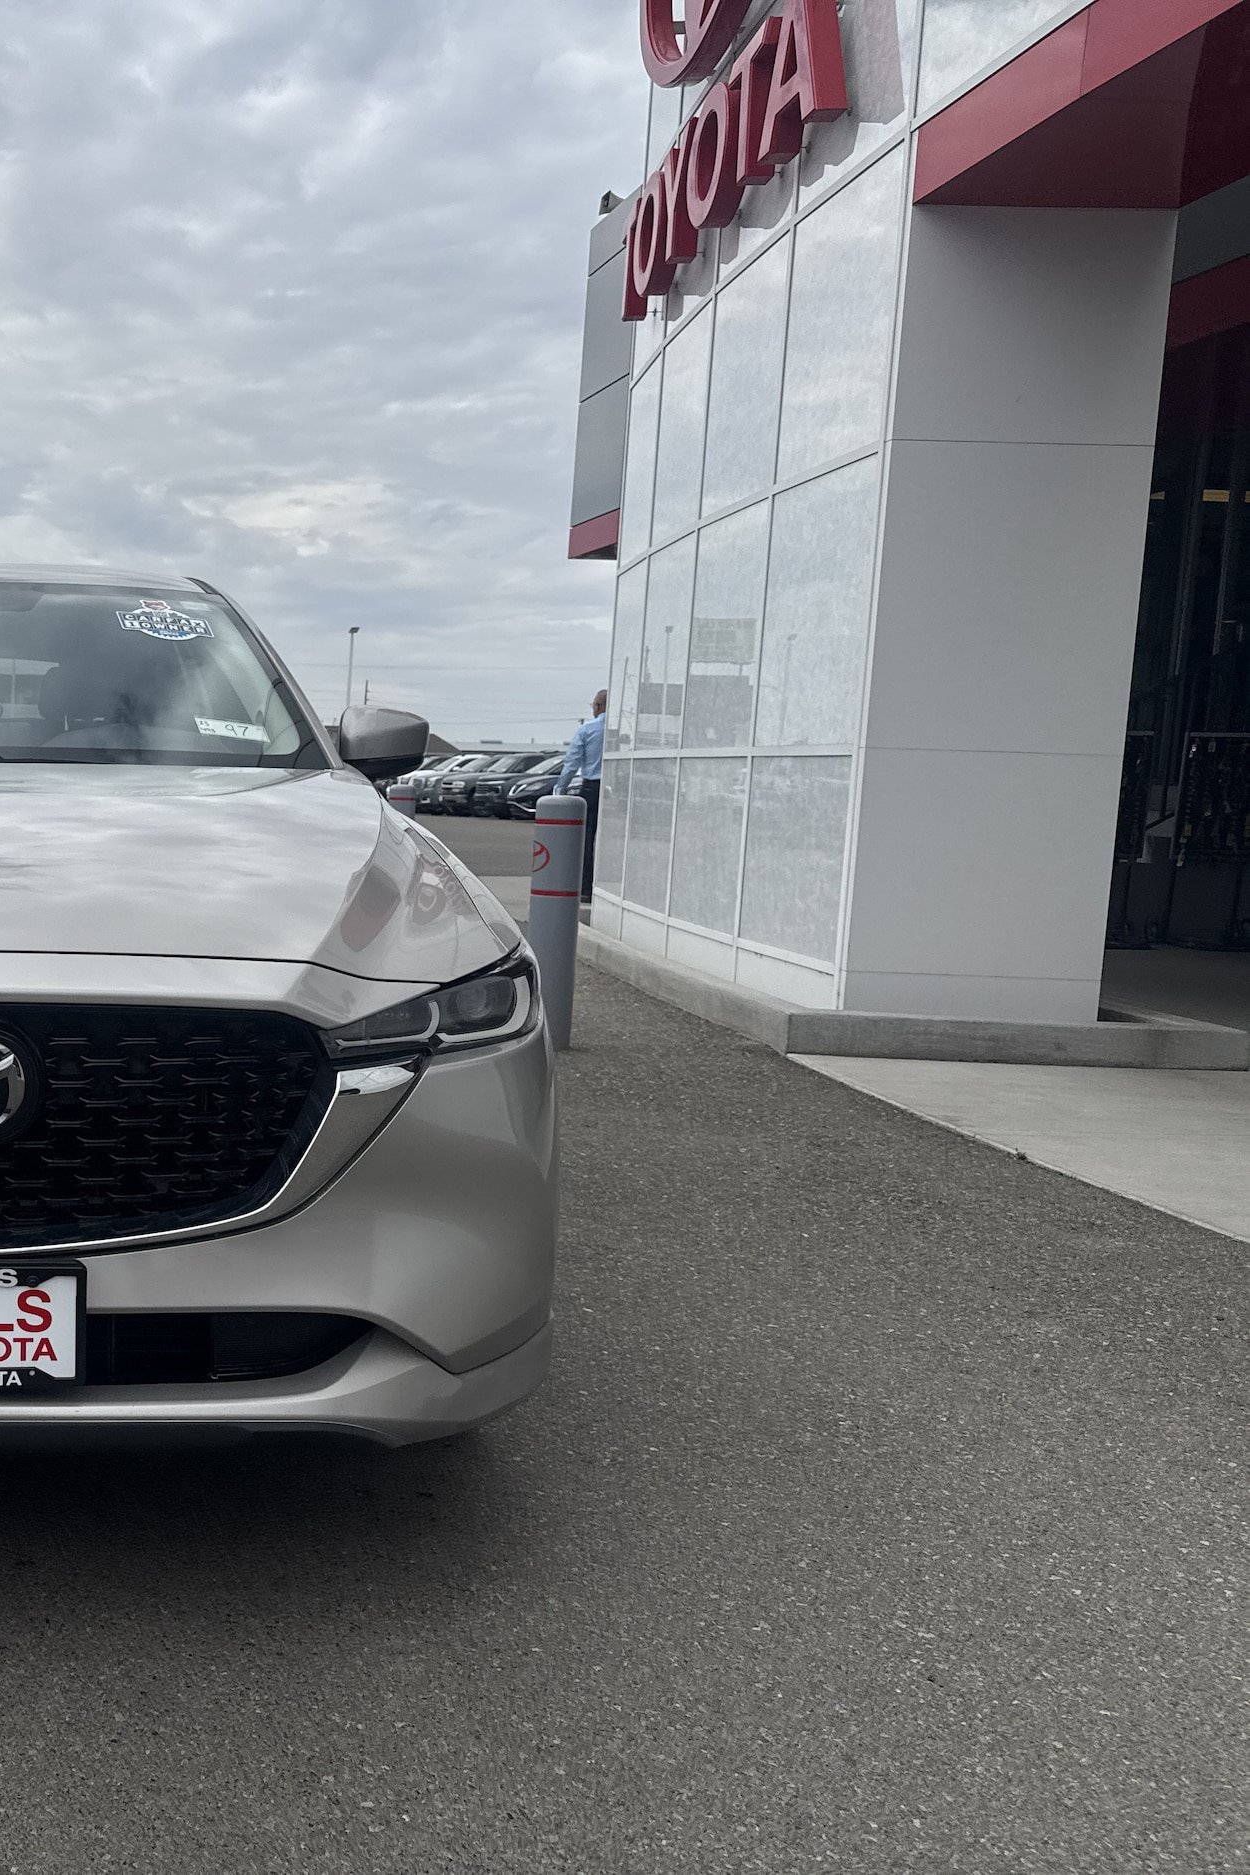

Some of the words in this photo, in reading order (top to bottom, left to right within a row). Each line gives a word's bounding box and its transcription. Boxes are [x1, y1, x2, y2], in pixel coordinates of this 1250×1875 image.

[621, 0, 848, 321] TOYOTA
[124, 614, 205, 626] CARFAX
[225, 723, 249, 737] 97
